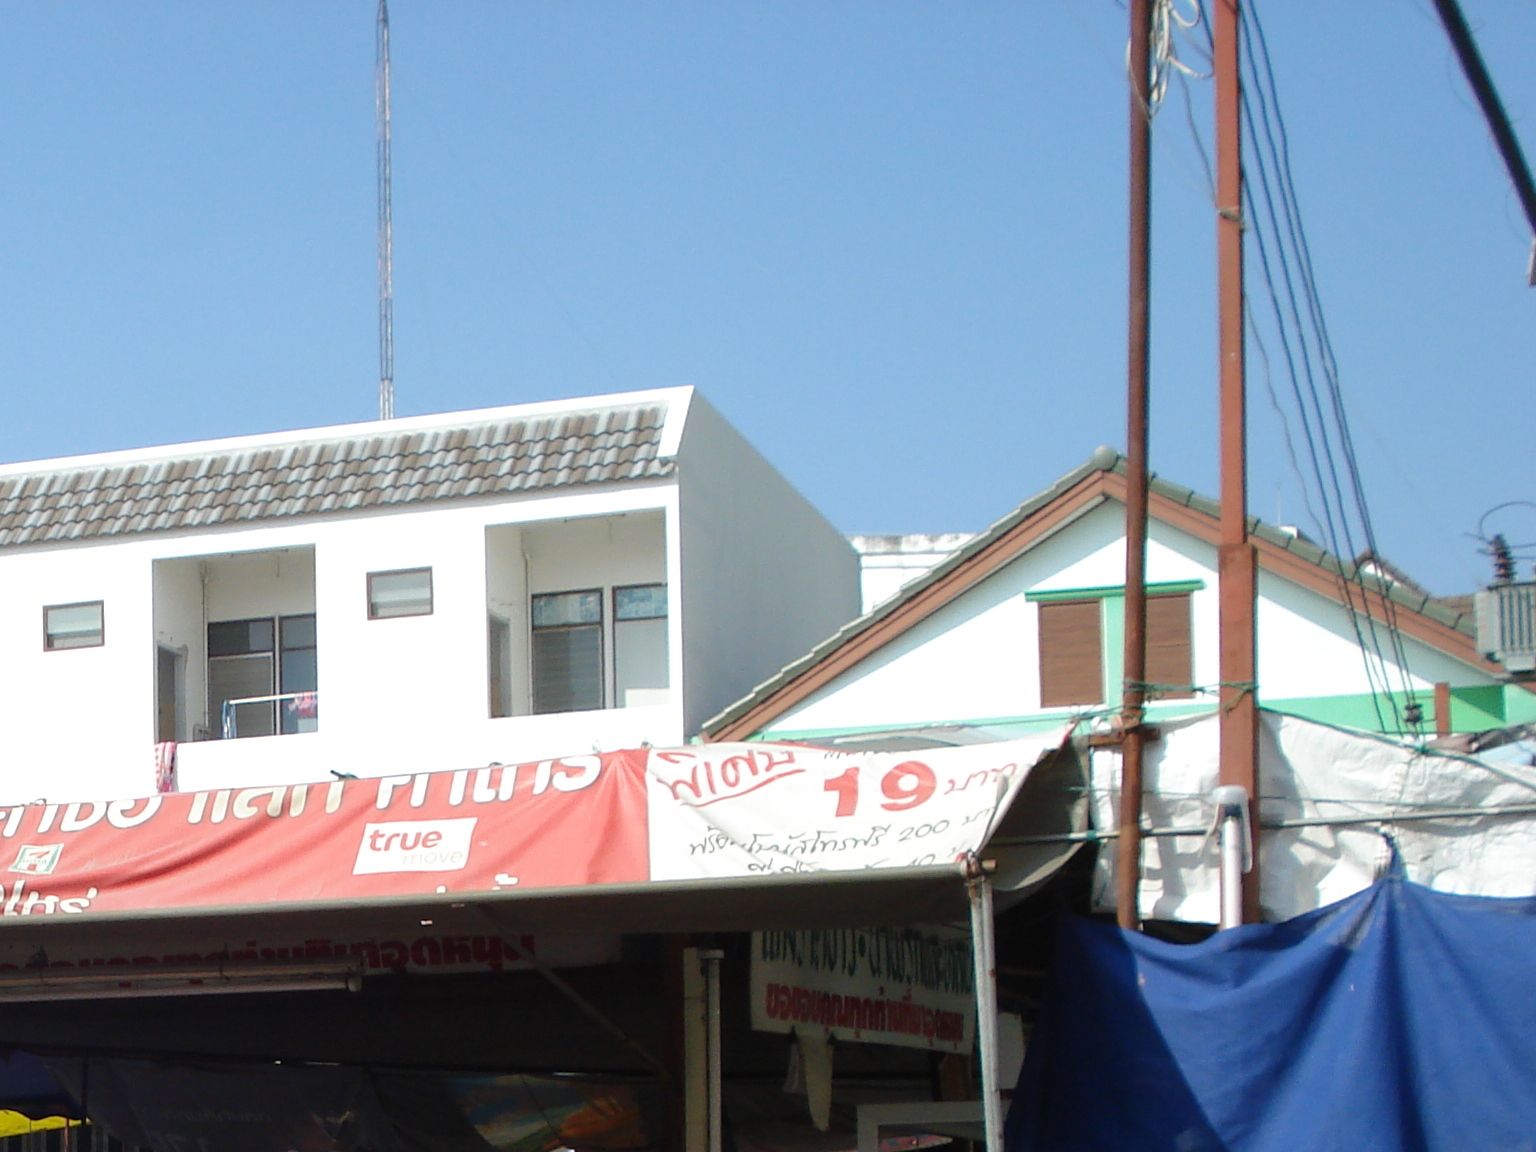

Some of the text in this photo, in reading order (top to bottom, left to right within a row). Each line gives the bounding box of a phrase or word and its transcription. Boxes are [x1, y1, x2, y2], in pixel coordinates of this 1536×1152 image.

[823, 760, 937, 818] 19
[368, 827, 443, 852] true
[898, 819, 951, 843] 200
[402, 848, 464, 866] move
